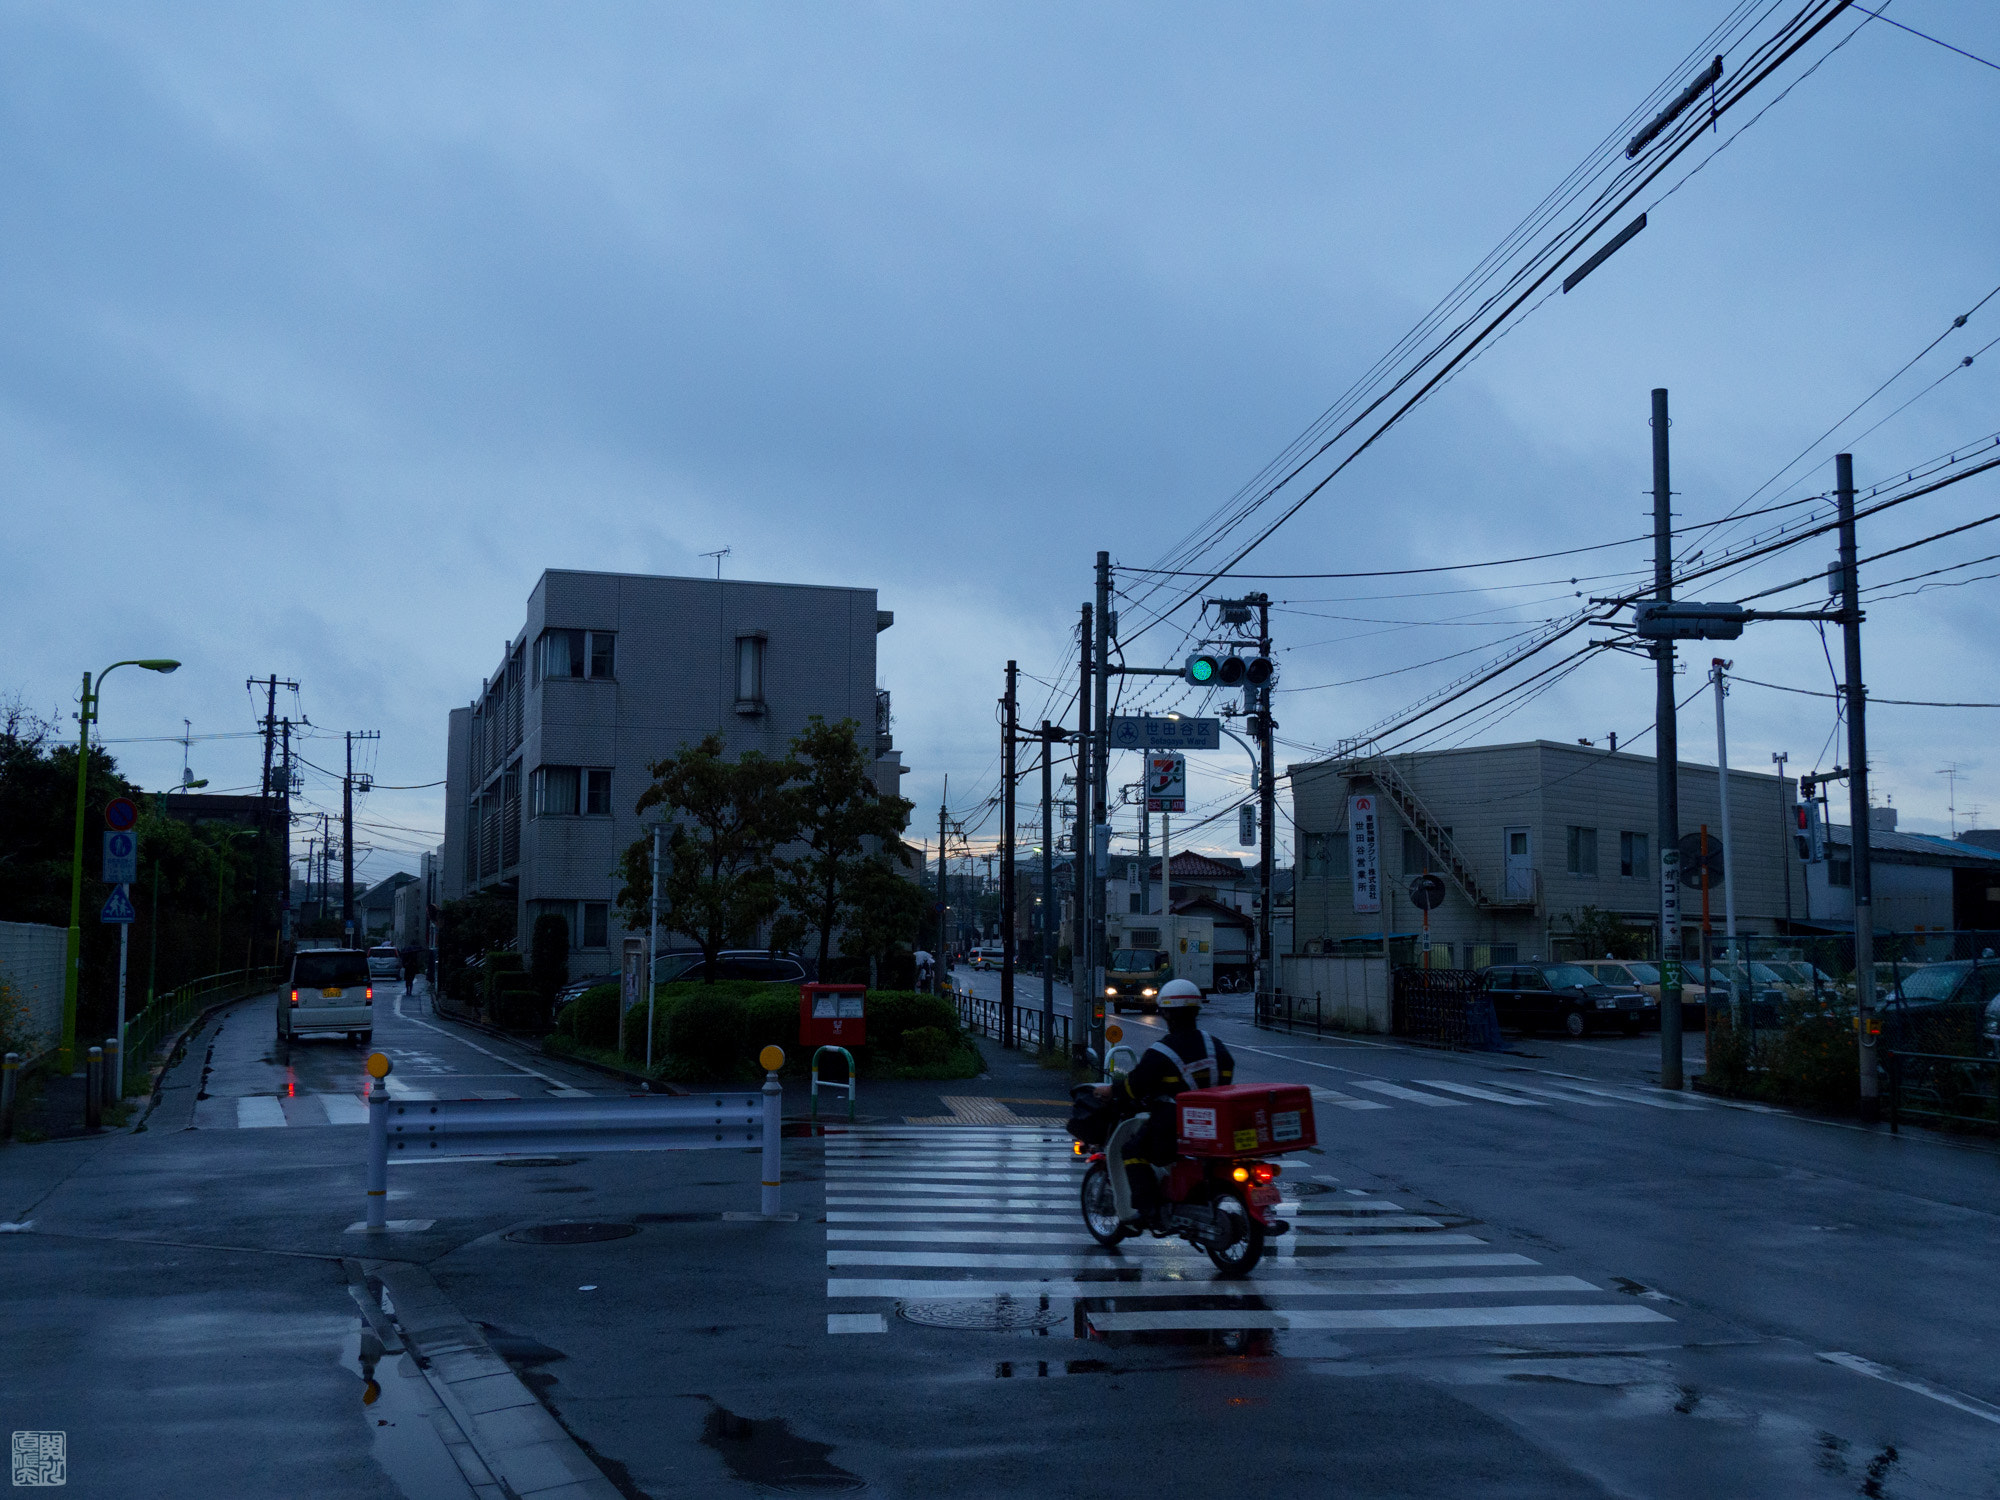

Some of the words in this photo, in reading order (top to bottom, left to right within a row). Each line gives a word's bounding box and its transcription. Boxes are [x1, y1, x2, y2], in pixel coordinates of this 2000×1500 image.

[1145, 721, 1210, 736] 世田谷区
[1150, 737, 1183, 746] Setagaya
[1187, 737, 1206, 745] Ward
[1355, 821, 1367, 892] 世田谷営業所
[1665, 884, 1676, 924] コタニ
[1666, 969, 1681, 986] 文
